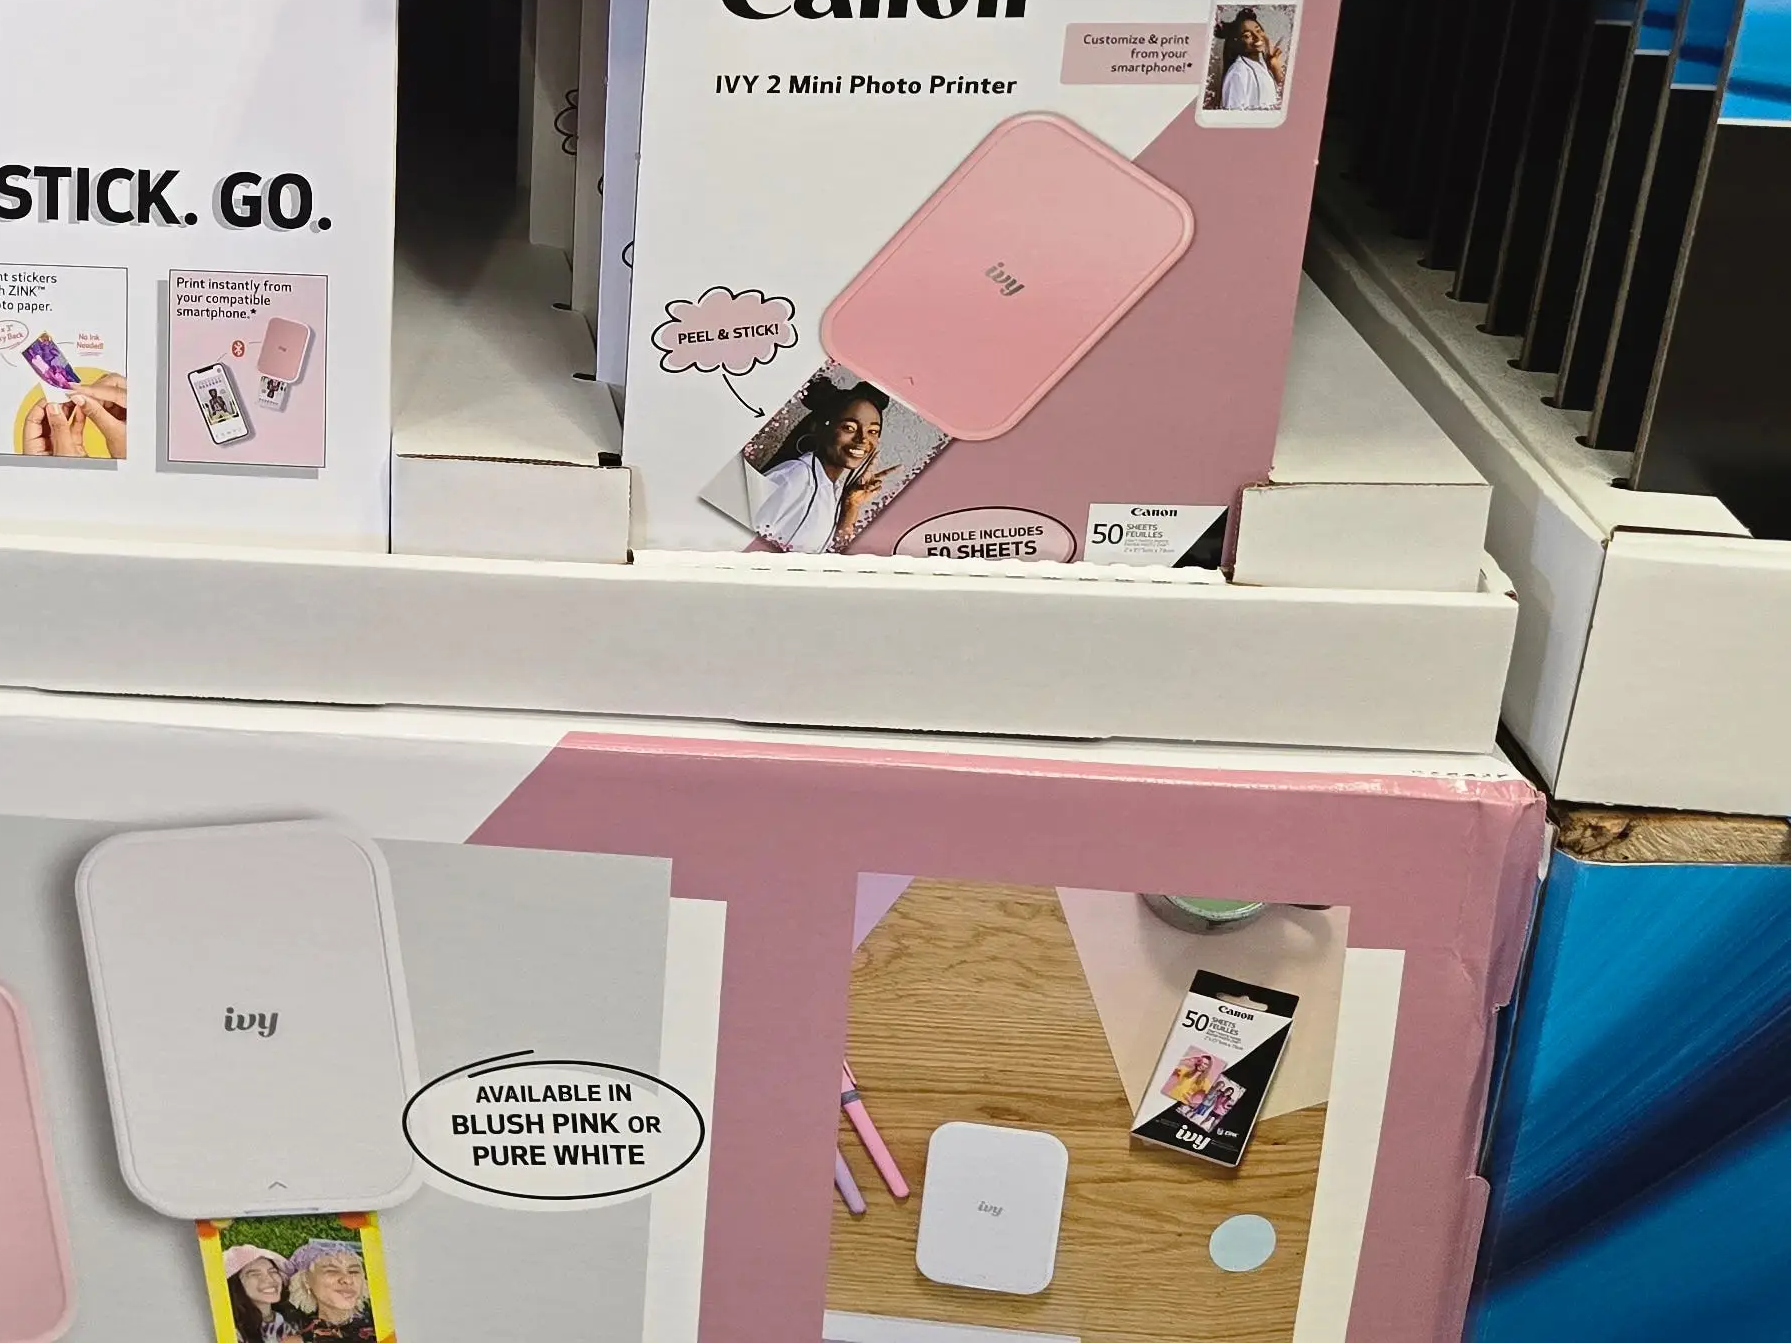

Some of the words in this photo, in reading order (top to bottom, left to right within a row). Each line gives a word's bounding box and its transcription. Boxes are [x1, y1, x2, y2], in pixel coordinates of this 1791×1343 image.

[1084, 34, 1145, 45] Customize
[1148, 34, 1158, 44] &
[1161, 35, 1189, 47] print
[1131, 48, 1159, 59] from
[1161, 51, 1187, 61] your
[716, 75, 759, 93] IVY
[767, 75, 780, 93] 2
[789, 75, 842, 94] Mini
[850, 75, 921, 94] Photo
[930, 76, 1017, 94] Printer
[221, 172, 331, 230] GO.
[12, 272, 57, 283] stickers
[177, 277, 205, 289] Print
[208, 278, 260, 294] instantly
[264, 281, 292, 292] from
[177, 295, 203, 305] your
[206, 289, 270, 307] compatible
[18, 303, 52, 314] paper.
[678, 331, 714, 345] PEEL
[718, 329, 729, 340] &
[733, 324, 779, 339] STICK!
[1131, 508, 1177, 517] Canon
[925, 531, 976, 543] BUNDLE
[980, 526, 1044, 540] INCLUDES
[1092, 524, 1123, 544] 50
[957, 541, 1037, 559] SHEETS
[225, 1007, 278, 1038] ivy
[1182, 1010, 1209, 1031] 50
[1219, 1006, 1254, 1021] Canon
[476, 1085, 601, 1103] AVAILABLE
[609, 1084, 632, 1101] IN
[452, 1114, 544, 1135] BLUSH
[553, 1113, 620, 1134] PINK
[629, 1116, 661, 1133] OR
[1176, 1125, 1211, 1150] ivy
[473, 1145, 546, 1166] PURE
[553, 1145, 645, 1165] WHITE
